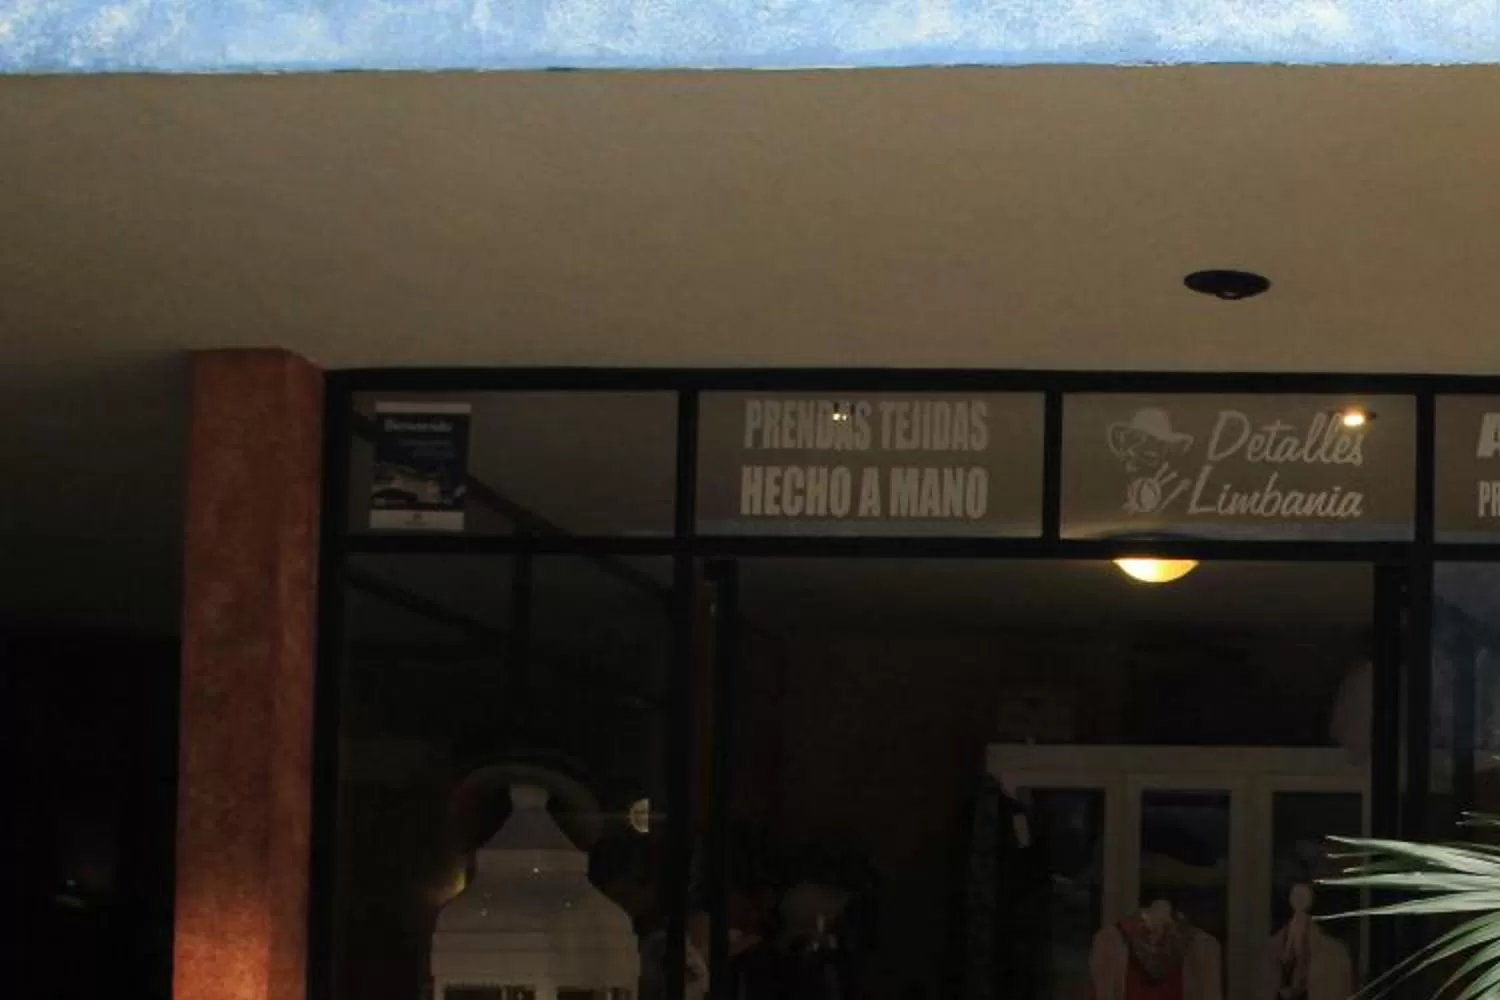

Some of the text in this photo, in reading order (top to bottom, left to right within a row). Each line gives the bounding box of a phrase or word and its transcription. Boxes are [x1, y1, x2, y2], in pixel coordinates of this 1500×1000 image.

[744, 400, 990, 451] PRENDAS TEJIDAS
[1208, 409, 1364, 466] Detalles
[740, 464, 990, 519] HECHO A MANO
[1187, 465, 1364, 518] Limbania
